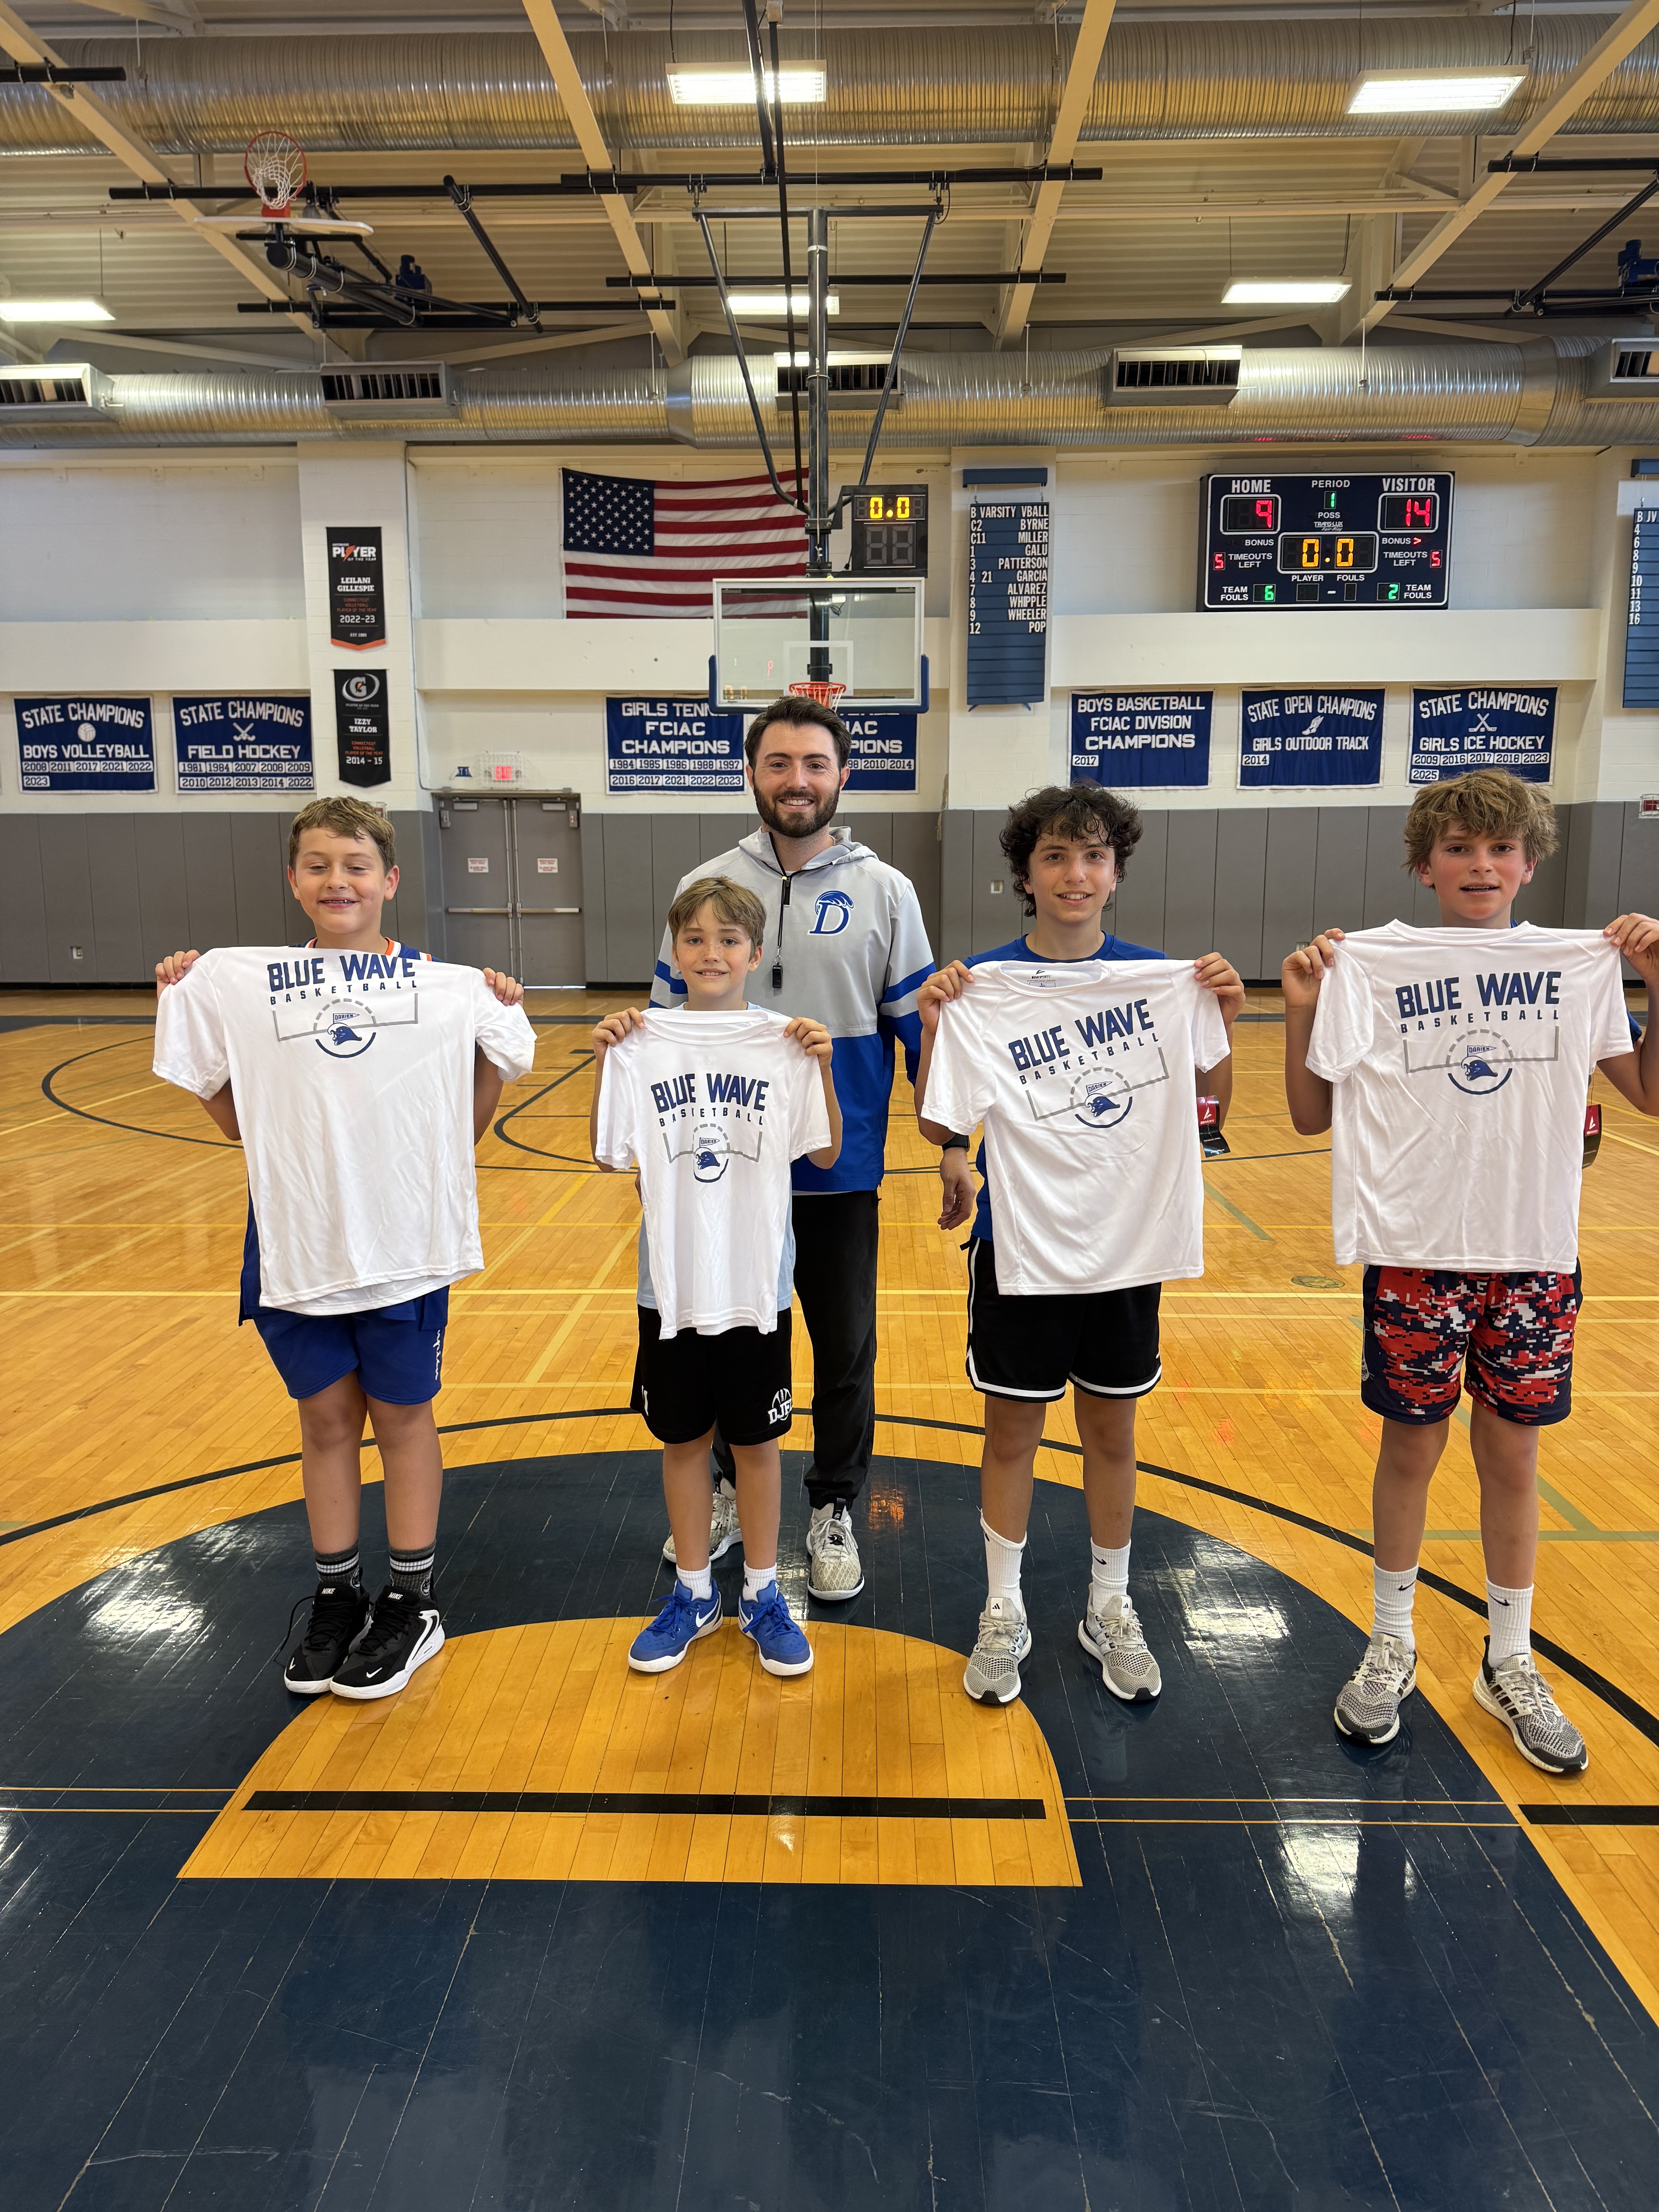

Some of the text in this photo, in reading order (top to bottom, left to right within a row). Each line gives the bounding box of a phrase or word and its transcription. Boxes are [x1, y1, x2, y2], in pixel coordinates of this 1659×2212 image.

[1231, 479, 1271, 493] HOME
[1382, 478, 1435, 491] VISITOR
[1330, 492, 1335, 508] 1
[870, 497, 910, 519] 0.0
[971, 505, 1049, 518] B VARSITY VBALL
[1255, 500, 1273, 528] 9
[1405, 498, 1431, 527] 14
[1637, 510, 1657, 522] B JV
[971, 518, 1049, 531] C2 BYRNE
[1634, 524, 1640, 535] 4
[970, 531, 1048, 544] C11 MILLER
[1634, 536, 1640, 548] 6
[970, 544, 1048, 557] 1 GALU
[1633, 549, 1639, 561] 8
[970, 557, 1048, 570] 3 PATTERSON
[1214, 553, 1224, 569] 5
[1431, 551, 1441, 567] 5
[1632, 562, 1638, 574] 9
[970, 570, 1047, 583] 4 21 GARCIA
[1631, 575, 1642, 587] 10
[970, 583, 1046, 596] 7 ALVAREZ
[1264, 585, 1274, 601] 6
[1388, 584, 1398, 599] 2
[1630, 588, 1641, 599] 11
[970, 596, 1046, 608] 8 WHIPPLE
[1630, 600, 1641, 612] 13
[970, 609, 1046, 622] 9 WHEELER
[1629, 613, 1640, 625] 16
[969, 622, 1046, 634] 12 POP
[622, 702, 728, 717] GIRLS TENN
[1078, 696, 1205, 713] BOYS BASKETBALL
[1247, 696, 1377, 722] STATE OPEN CHAMPIONS
[1419, 690, 1549, 719] STATE CHAMPIONS
[22, 702, 145, 728] STATE CHAMPIONS
[180, 701, 304, 727] STATE CHAMPIONS
[646, 721, 706, 736] FCIAC
[1091, 715, 1191, 731] FCIAC DIVISION
[622, 740, 730, 754] CHAMPIONS
[1085, 734, 1195, 750] CHAMPIONS
[1253, 736, 1369, 752] GIRLS OUTDOOR TRACK
[1420, 735, 1545, 751] GIRLS ICE HOCKEY
[24, 744, 149, 758] BOYS VOLLEYBALL
[188, 745, 301, 759] FIELD HOCKEY
[612, 760, 740, 769] 1984 1985 1986 1988 1997
[864, 760, 912, 769] 2010 2014
[1074, 756, 1097, 766] 2017
[1244, 756, 1267, 765] 2014
[1414, 753, 1547, 764] 2009 2016 2017 2018 2023
[24, 762, 152, 772] 2008 2011 2017 2021 2022
[182, 763, 311, 773] 1981 1984 2007 2008 2009
[24, 776, 48, 786] 2023
[612, 776, 741, 785] 2016 2017 2021 2022 2023
[1413, 770, 1437, 780] 2025
[182, 777, 312, 788] 2010 2012 2013 2014 2022
[267, 953, 416, 992] BLUE WAVE
[270, 980, 417, 1005] BASKETBALL
[1395, 971, 1562, 1019] BLUE WAVE
[1400, 1010, 1558, 1034] BASKETBALL
[1008, 998, 1154, 1072] BLUE WAVE
[1019, 1033, 1159, 1085] BASKETBALL
[651, 1073, 770, 1113] BLUE WAVE
[659, 1107, 763, 1127] BASKETBALL
